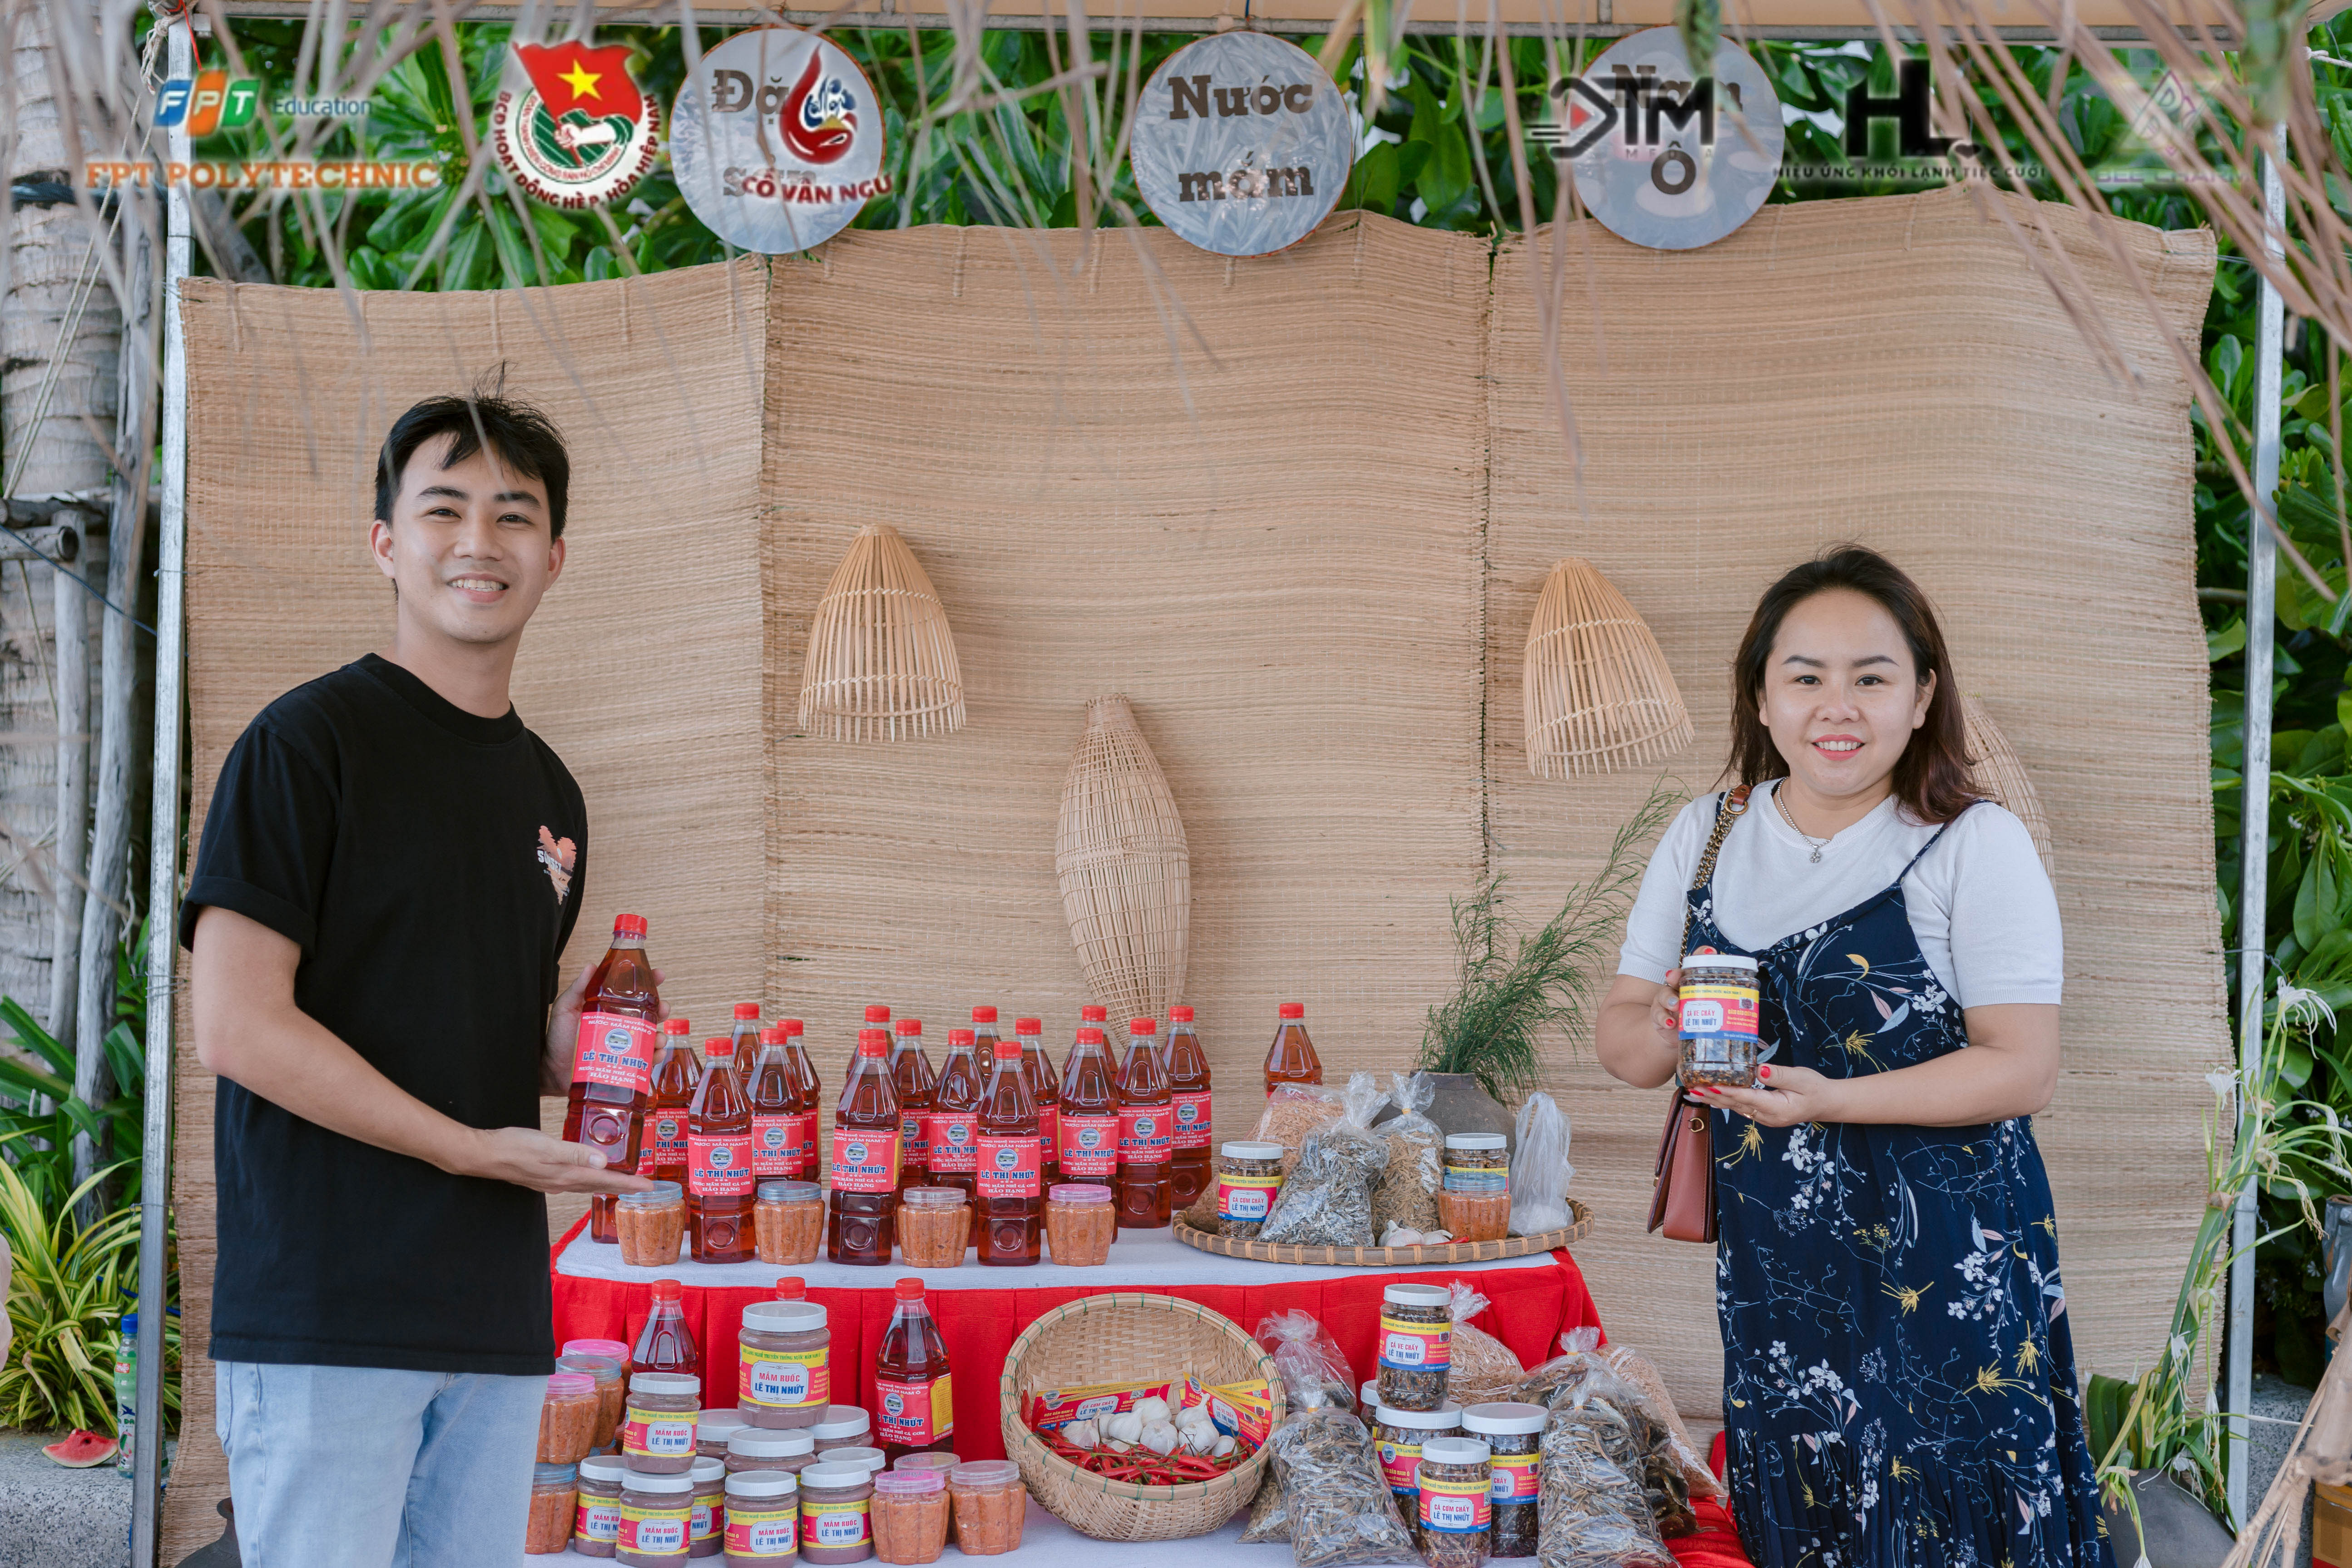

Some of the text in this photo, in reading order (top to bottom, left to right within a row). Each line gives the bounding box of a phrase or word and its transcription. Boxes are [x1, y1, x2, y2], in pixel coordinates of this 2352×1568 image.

[712, 69, 789, 125] Đặ
[1168, 74, 1313, 119] Nước
[1650, 140, 1697, 195] Ô
[1178, 151, 1314, 202] mắm
[537, 850, 562, 875] SUNSET
[1686, 1018, 1690, 1026] LÊ
[582, 1049, 648, 1071] LÊ THỊ NHỨT
[1175, 1121, 1211, 1133] THỊ NHỨT
[1119, 1136, 1170, 1148] LÊ THỊ NHỨT
[761, 1148, 801, 1159] THỊ NHỨT
[1065, 1148, 1114, 1159] LÊ THỊ NHỨT
[694, 1167, 749, 1179] LÊ THỊ NHỨT
[832, 1162, 886, 1175] LÊ THỊ NHỨT
[981, 1169, 1035, 1181] LÊ THỊ NHỨT
[759, 1371, 777, 1381] MẮM
[780, 1373, 800, 1382] RUỐC
[755, 1382, 804, 1395] LÊ THỊ NHỨT
[882, 1415, 924, 1427] THỊ NHỨT
[652, 1437, 659, 1445] LÊ
[664, 1438, 672, 1447] THỊ
[1442, 1514, 1452, 1522] THỊ
[776, 1527, 789, 1535] RUỐC
[822, 1527, 859, 1538] LÊ THỊ NHỨT
[642, 1534, 680, 1544] LÊ THỊ NHỨT
[756, 1535, 791, 1546] LÊ THỊ NHỨT
